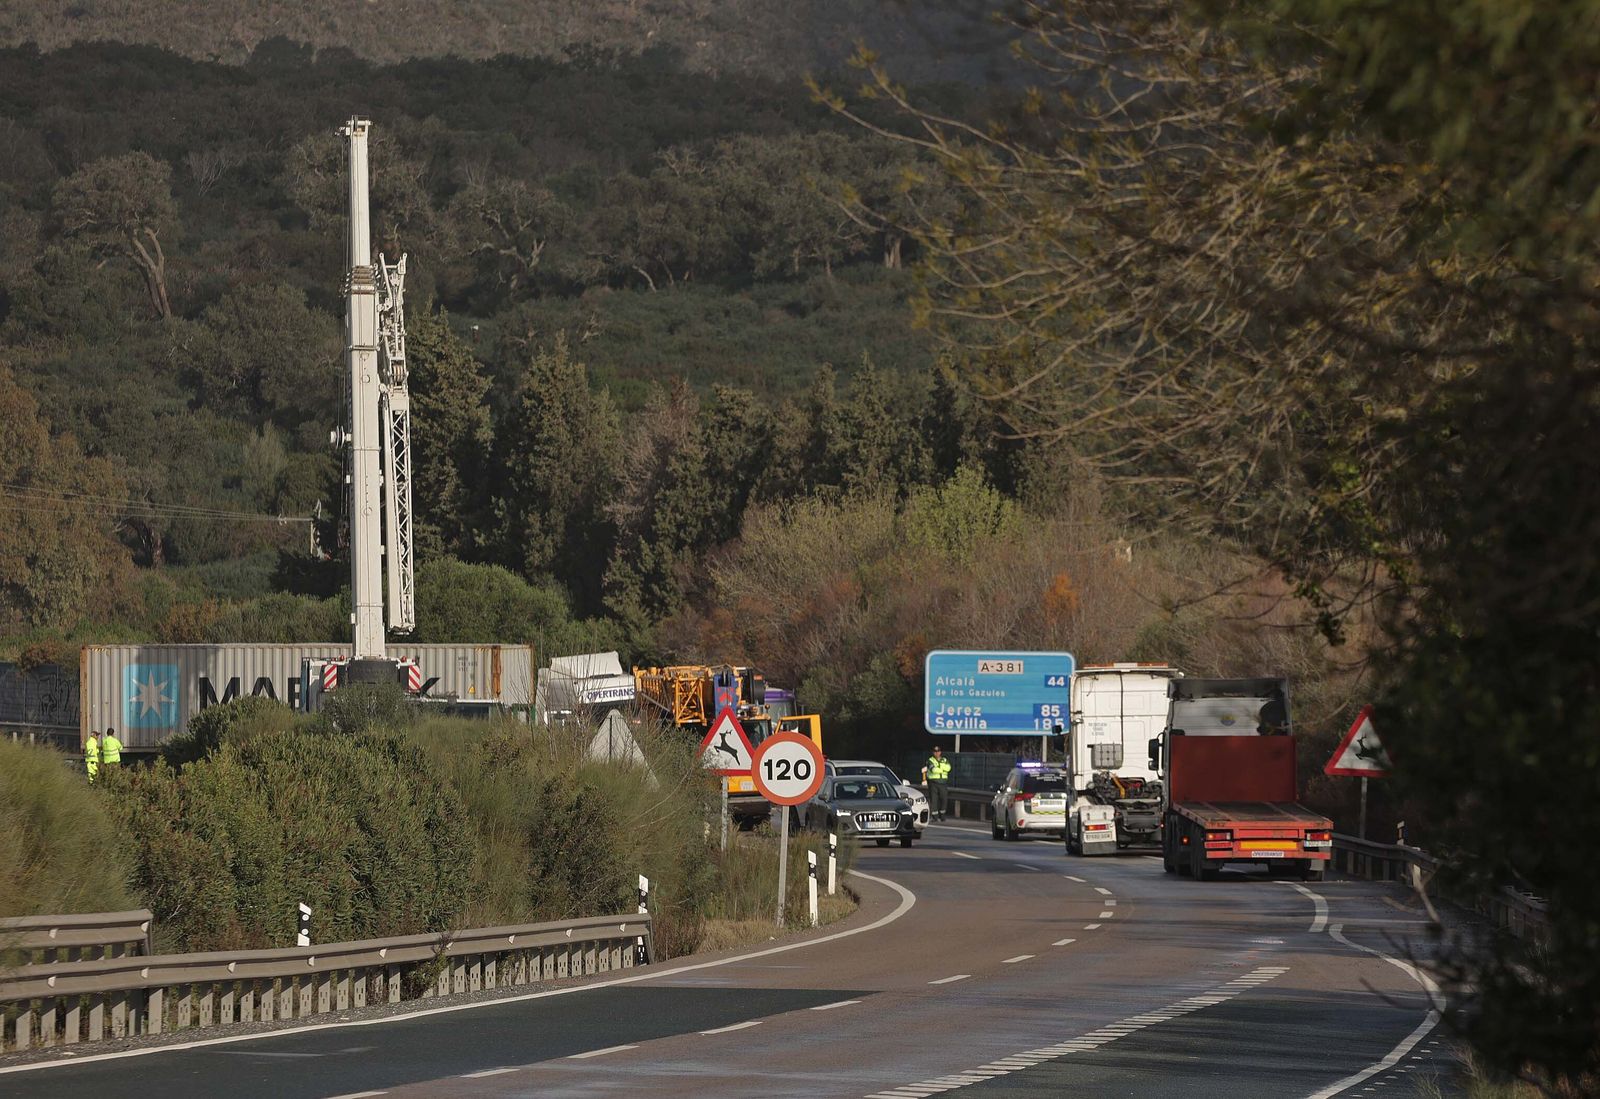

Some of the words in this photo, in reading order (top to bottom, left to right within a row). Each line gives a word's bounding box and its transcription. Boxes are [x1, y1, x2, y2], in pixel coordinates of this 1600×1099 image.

[981, 662, 1022, 673] A-381
[936, 676, 975, 686] Alcalá
[1047, 676, 1065, 687] 44
[968, 689, 1006, 697] Gazules
[935, 704, 982, 717] Jerez
[1041, 705, 1061, 717] 85
[935, 717, 988, 730] Sevilla
[1034, 718, 1065, 731] 185
[764, 759, 811, 780] 120
